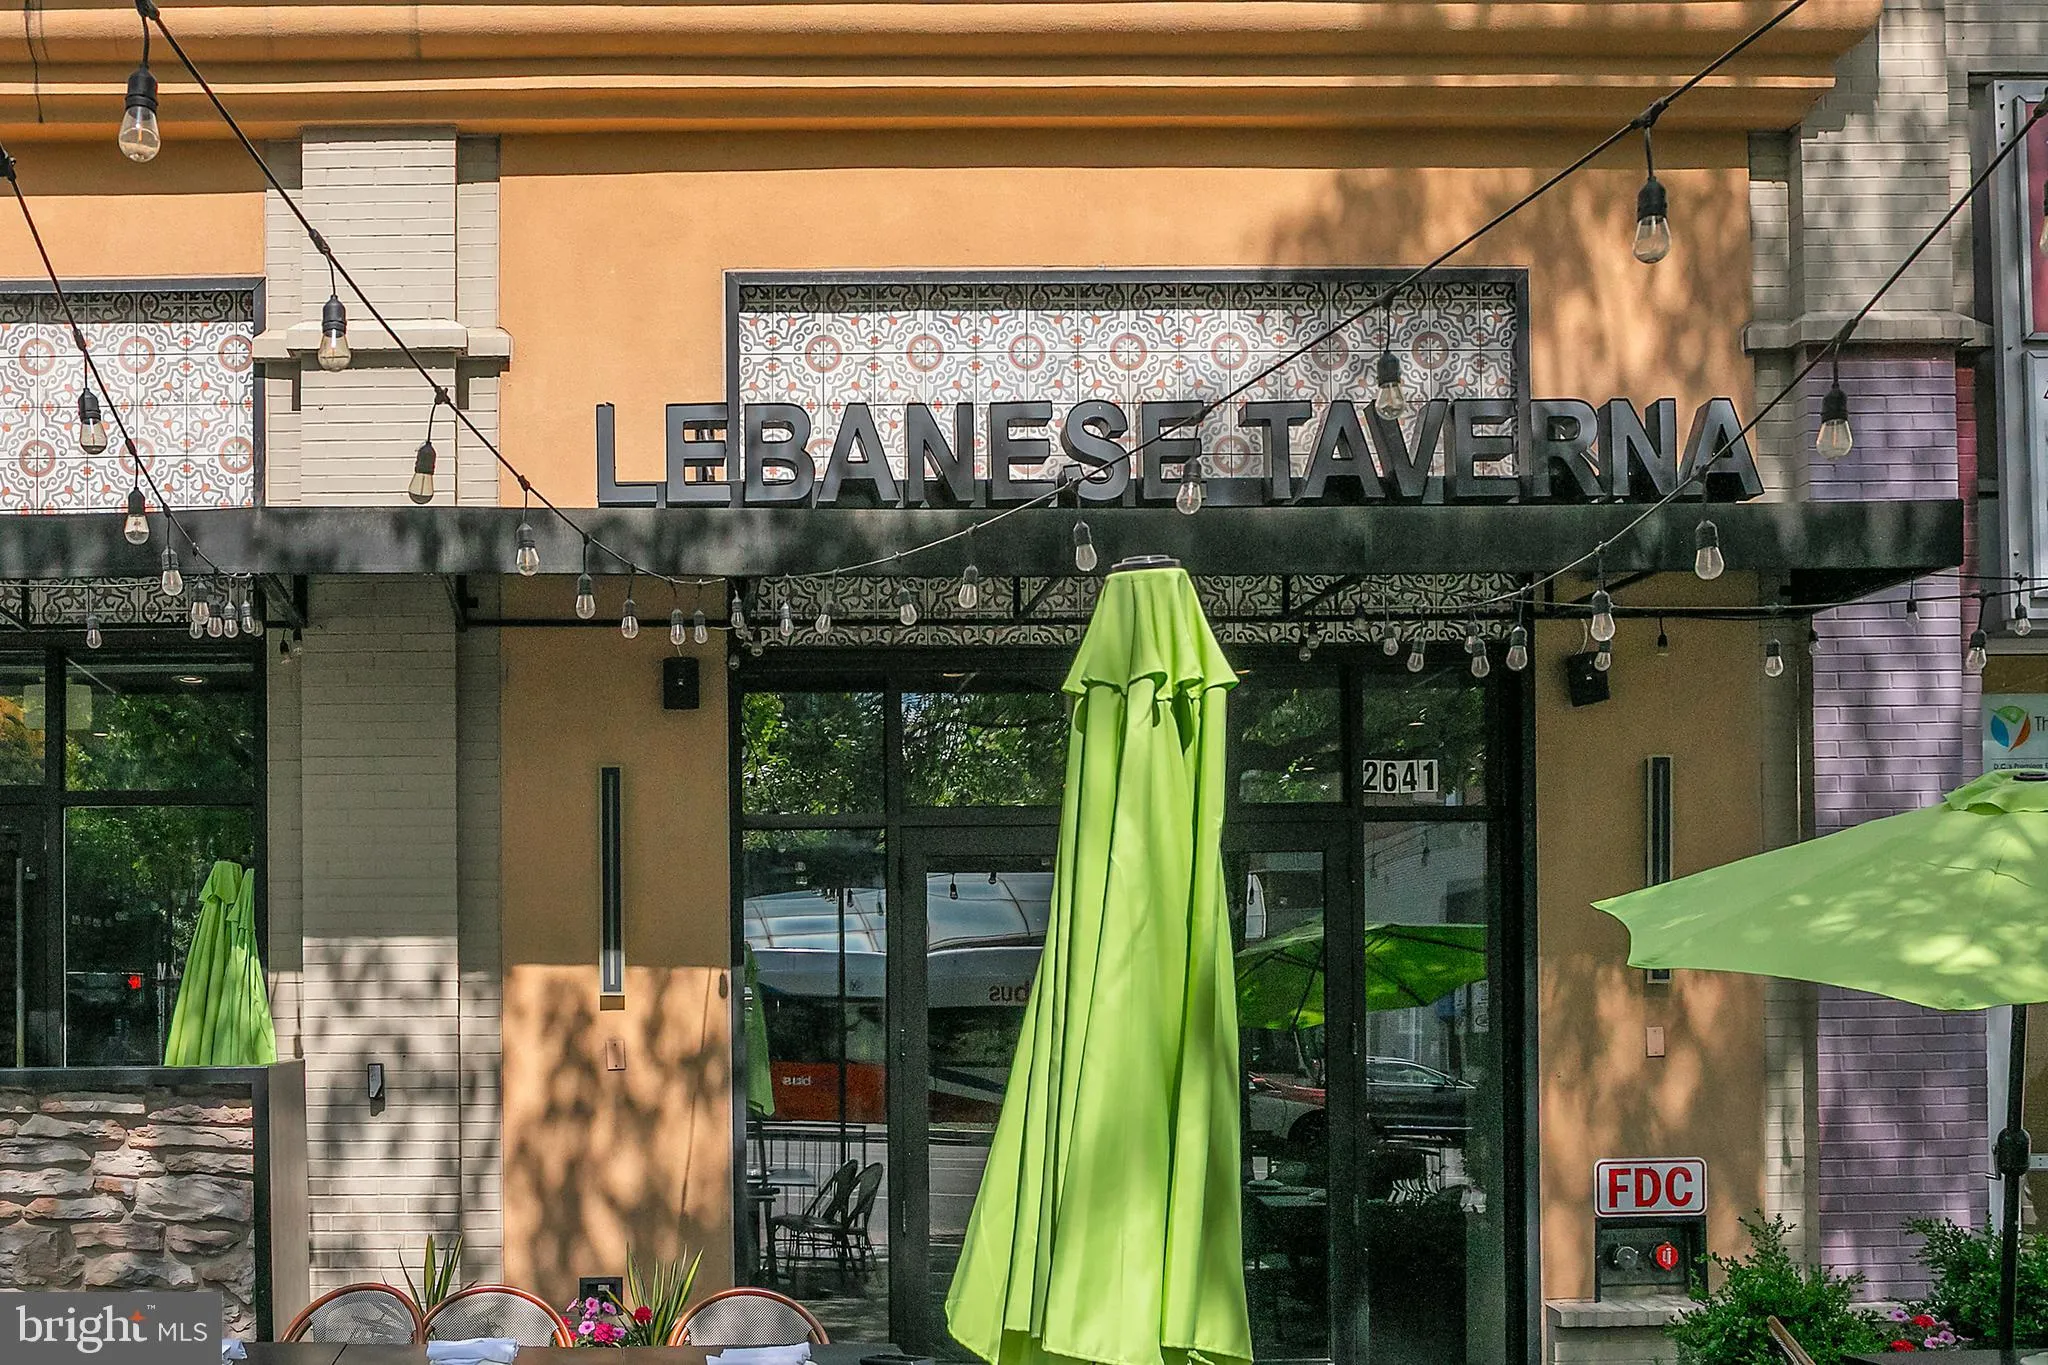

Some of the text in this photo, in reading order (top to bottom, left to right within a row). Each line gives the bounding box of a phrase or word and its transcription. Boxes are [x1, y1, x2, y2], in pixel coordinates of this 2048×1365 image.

[596, 397, 1765, 503] LEBANESE TAVERNA
[1363, 761, 1434, 792] 2641
[1608, 1166, 1694, 1208] FDC
